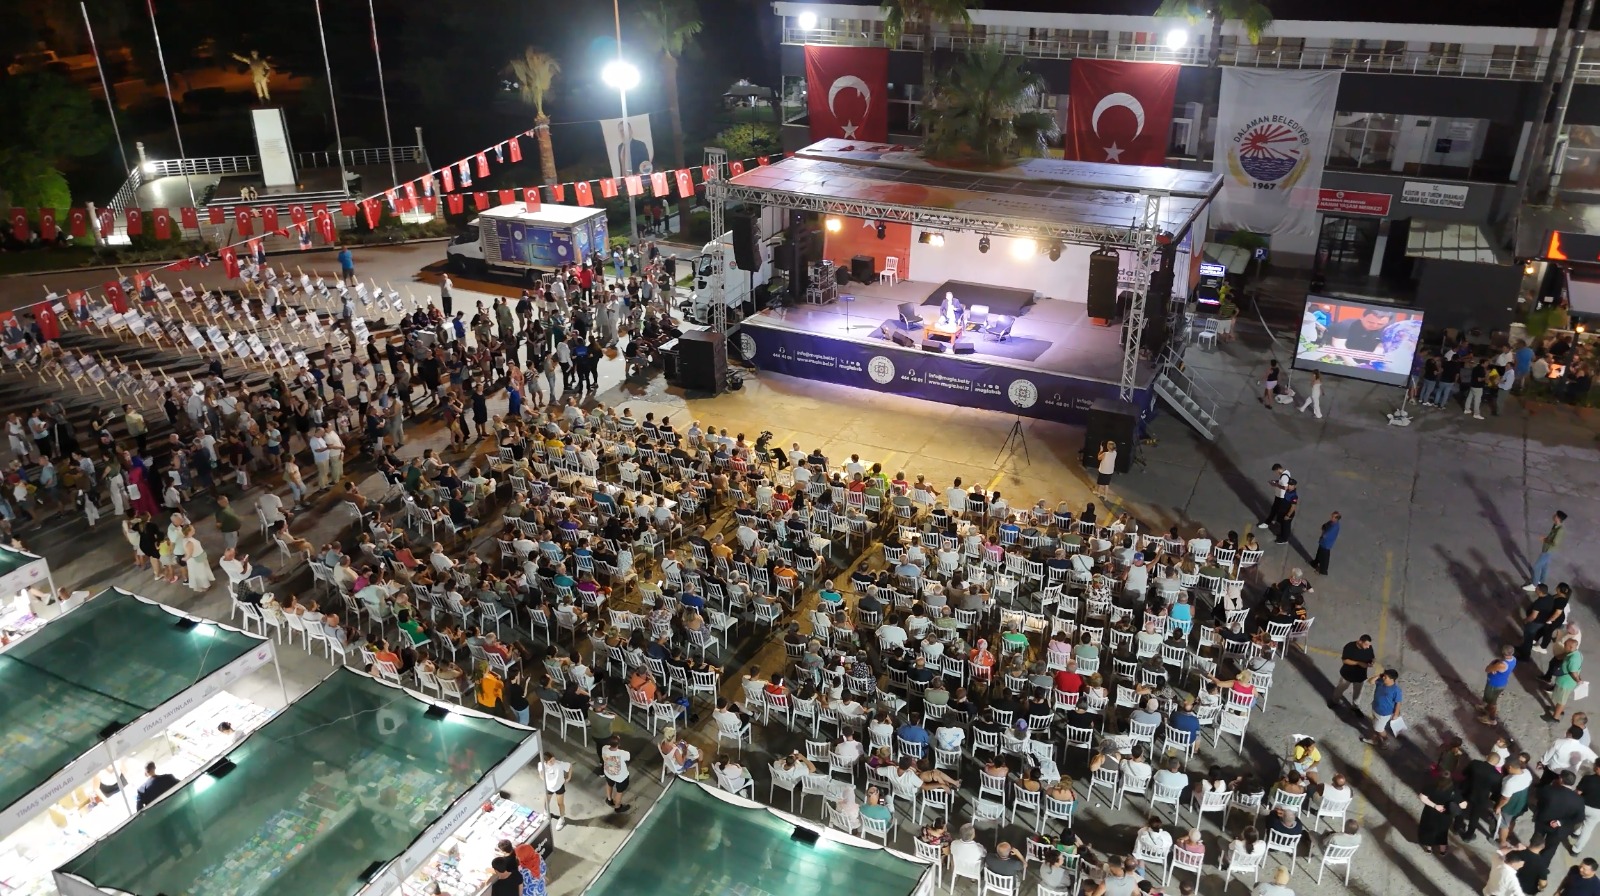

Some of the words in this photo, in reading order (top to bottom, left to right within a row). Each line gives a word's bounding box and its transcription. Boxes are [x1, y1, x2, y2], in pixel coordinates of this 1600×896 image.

[1233, 116, 1269, 143] DALAMAN
[1252, 182, 1277, 190] 1967
[1255, 248, 1263, 258] P
[142, 717, 163, 733] TİMAŞ
[164, 698, 194, 720] YAYINLARI
[40, 777, 74, 801] YAYINLARI
[431, 822, 453, 844] DOĞAN
[451, 807, 468, 826] KİTAP
